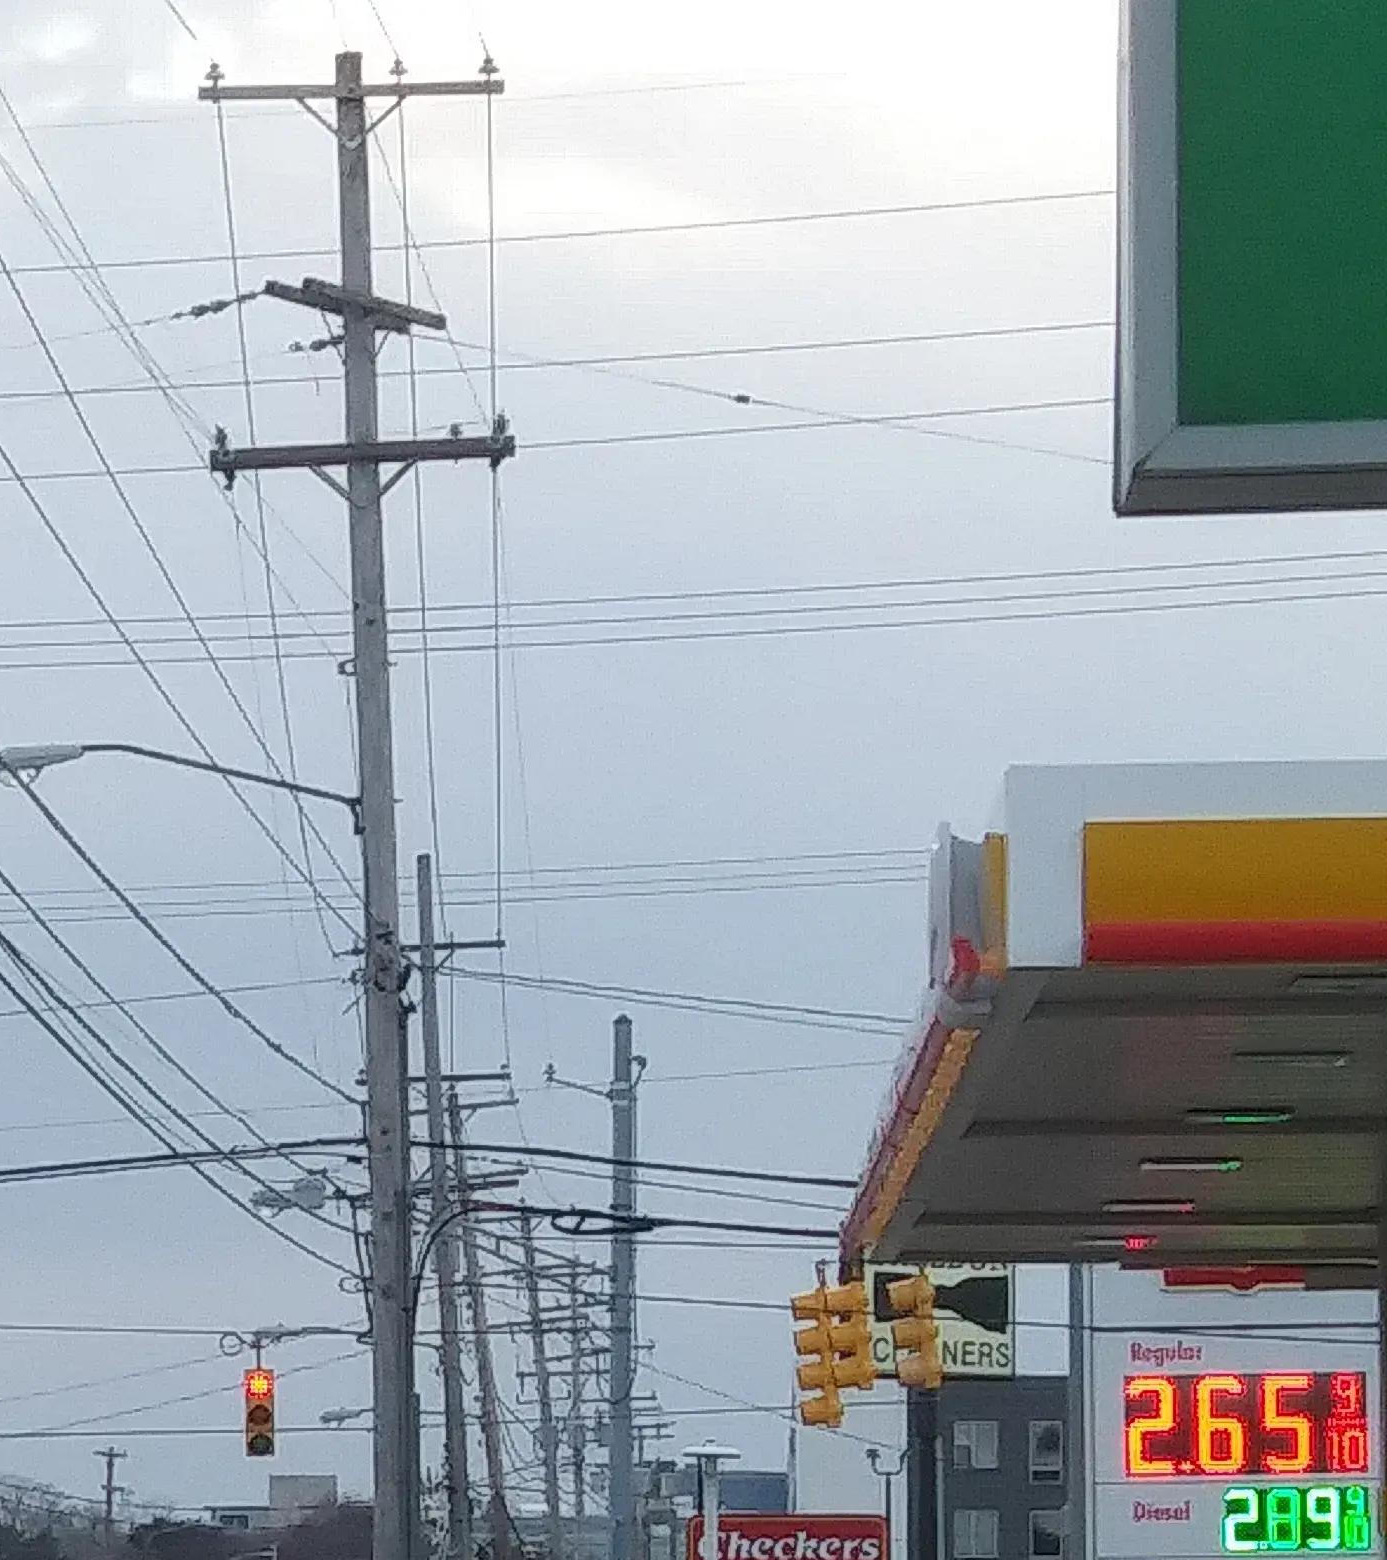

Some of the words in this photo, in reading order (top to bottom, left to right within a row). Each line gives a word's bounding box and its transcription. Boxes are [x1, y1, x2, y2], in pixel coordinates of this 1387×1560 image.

[872, 1337, 1012, 1368] CNERS
[1130, 1340, 1203, 1367] Regular
[1132, 1500, 1192, 1521] Diesel
